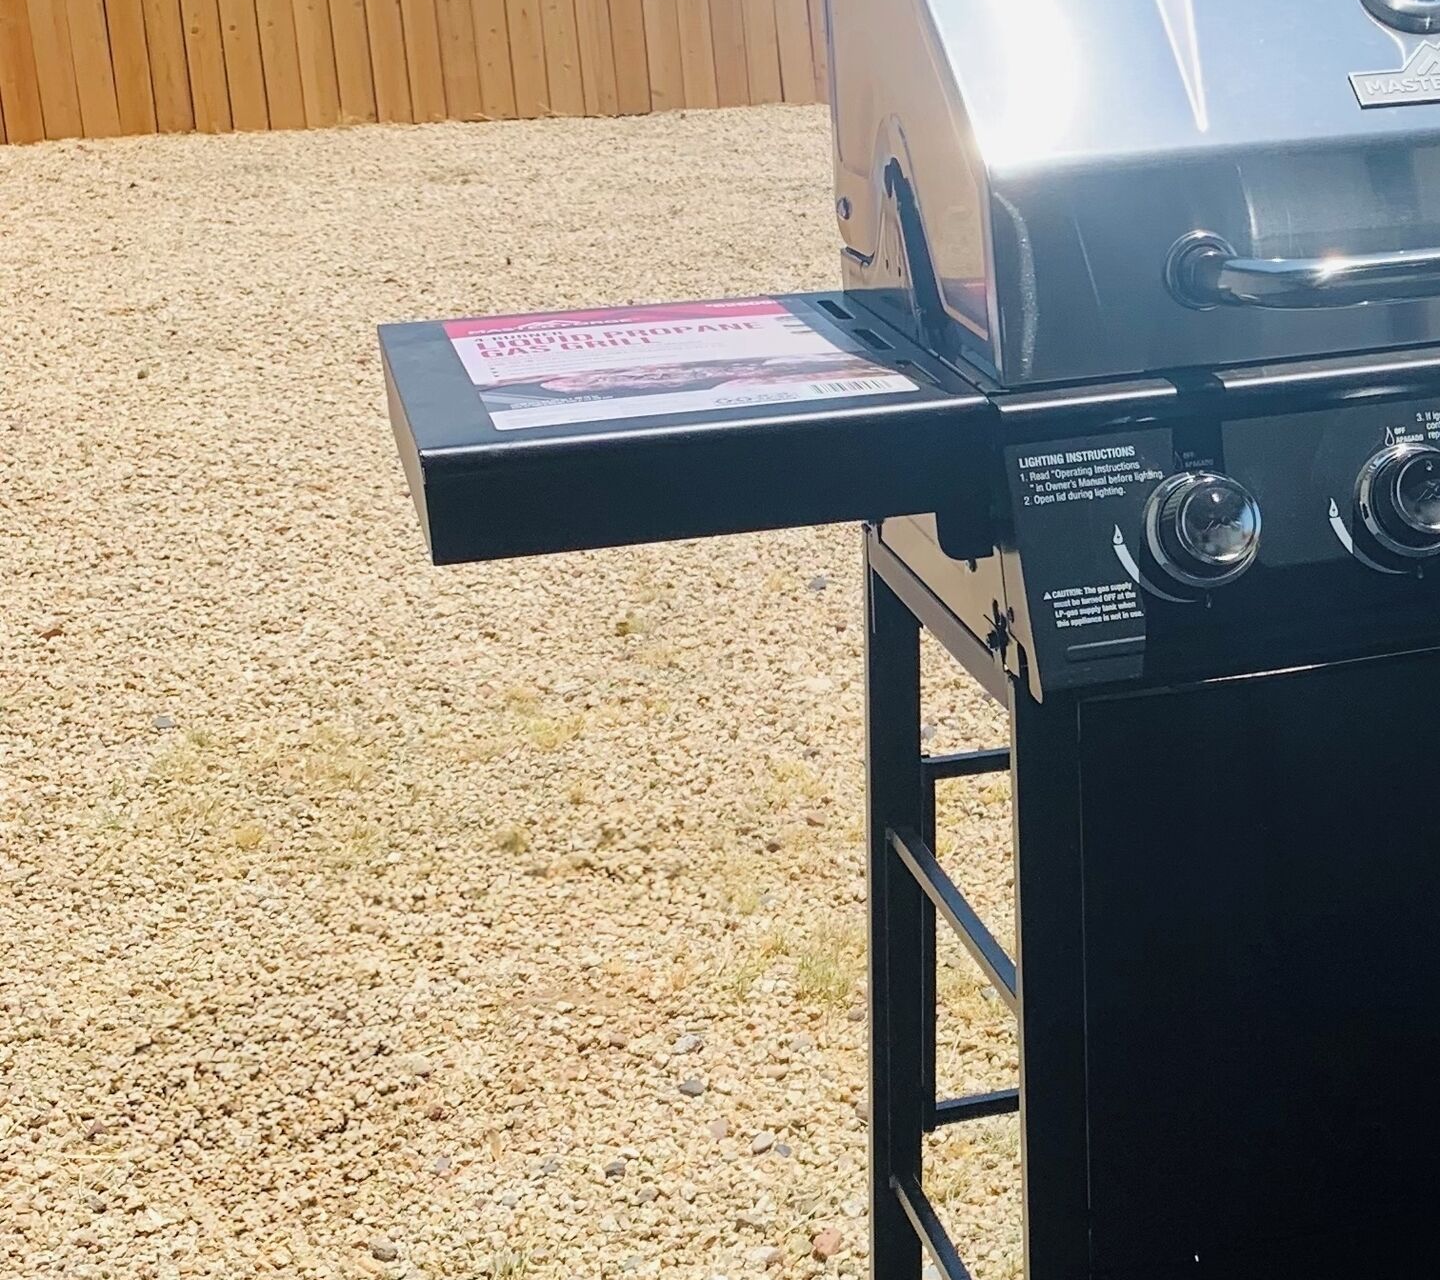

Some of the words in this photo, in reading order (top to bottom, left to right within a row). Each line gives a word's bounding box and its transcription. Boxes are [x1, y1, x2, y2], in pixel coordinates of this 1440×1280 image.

[476, 333, 594, 349] LIQUID
[603, 322, 764, 338] PROPANE
[480, 345, 551, 358] GAS
[560, 337, 661, 350] GRILL
[1416, 413, 1424, 421] 3.
[1425, 412, 1431, 420] If
[1019, 454, 1064, 468] LIGHTING
[1066, 446, 1135, 463] INSTRUCTIONS
[1020, 474, 1028, 482] 1.
[1030, 471, 1050, 480] Read
[1094, 462, 1140, 473] Instructions
[1036, 484, 1044, 492] in
[1045, 480, 1076, 491] Owner's
[1078, 477, 1106, 487] Manual
[1108, 474, 1133, 484] before
[1134, 470, 1165, 482] lighting.
[1033, 494, 1055, 504] Open
[1056, 493, 1066, 501] lid
[1068, 490, 1093, 500] during
[1094, 486, 1126, 498] lighting.
